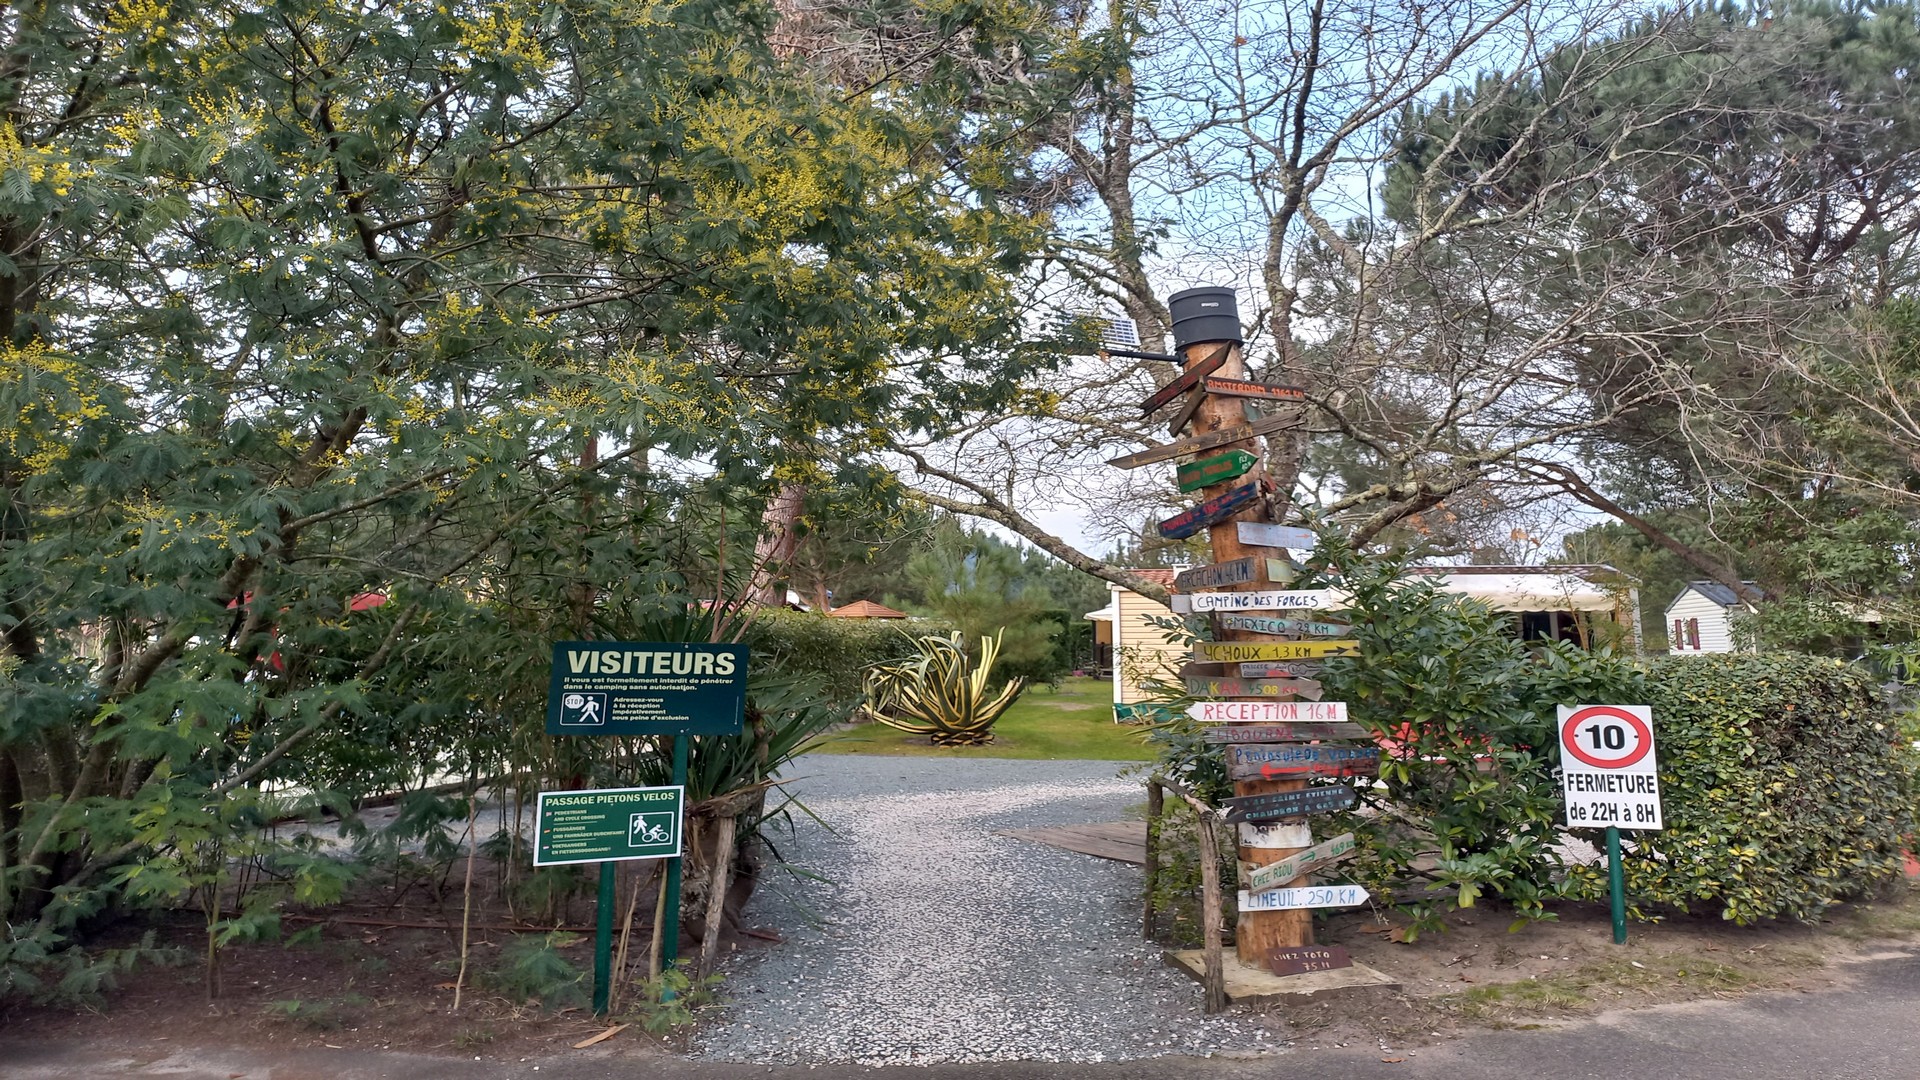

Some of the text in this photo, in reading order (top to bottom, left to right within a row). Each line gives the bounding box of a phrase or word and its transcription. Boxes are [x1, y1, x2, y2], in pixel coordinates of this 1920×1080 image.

[1207, 380, 1266, 395] AMSTERDAM
[1254, 596, 1272, 606] DES
[1233, 618, 1286, 633] MEXICO
[1314, 624, 1328, 634] KM
[1204, 646, 1261, 661] YCHOUX
[1295, 646, 1312, 658] KM
[568, 650, 736, 675] VISITEURS
[1190, 679, 1240, 695] DAKAR
[1306, 704, 1322, 719] 16
[1327, 704, 1336, 720] M
[1217, 726, 1294, 741] LIBOURNE
[1585, 724, 1625, 750] 10
[1567, 774, 1656, 794] FERMETURE
[546, 792, 675, 806] PASSAGE PIETONS VELOS
[1246, 806, 1298, 820] CHAUDRON
[1570, 802, 1656, 822] de 22H à 8H
[1252, 872, 1271, 888] CHEZ
[1308, 890, 1333, 905] 250
[1340, 889, 1356, 904] KM
